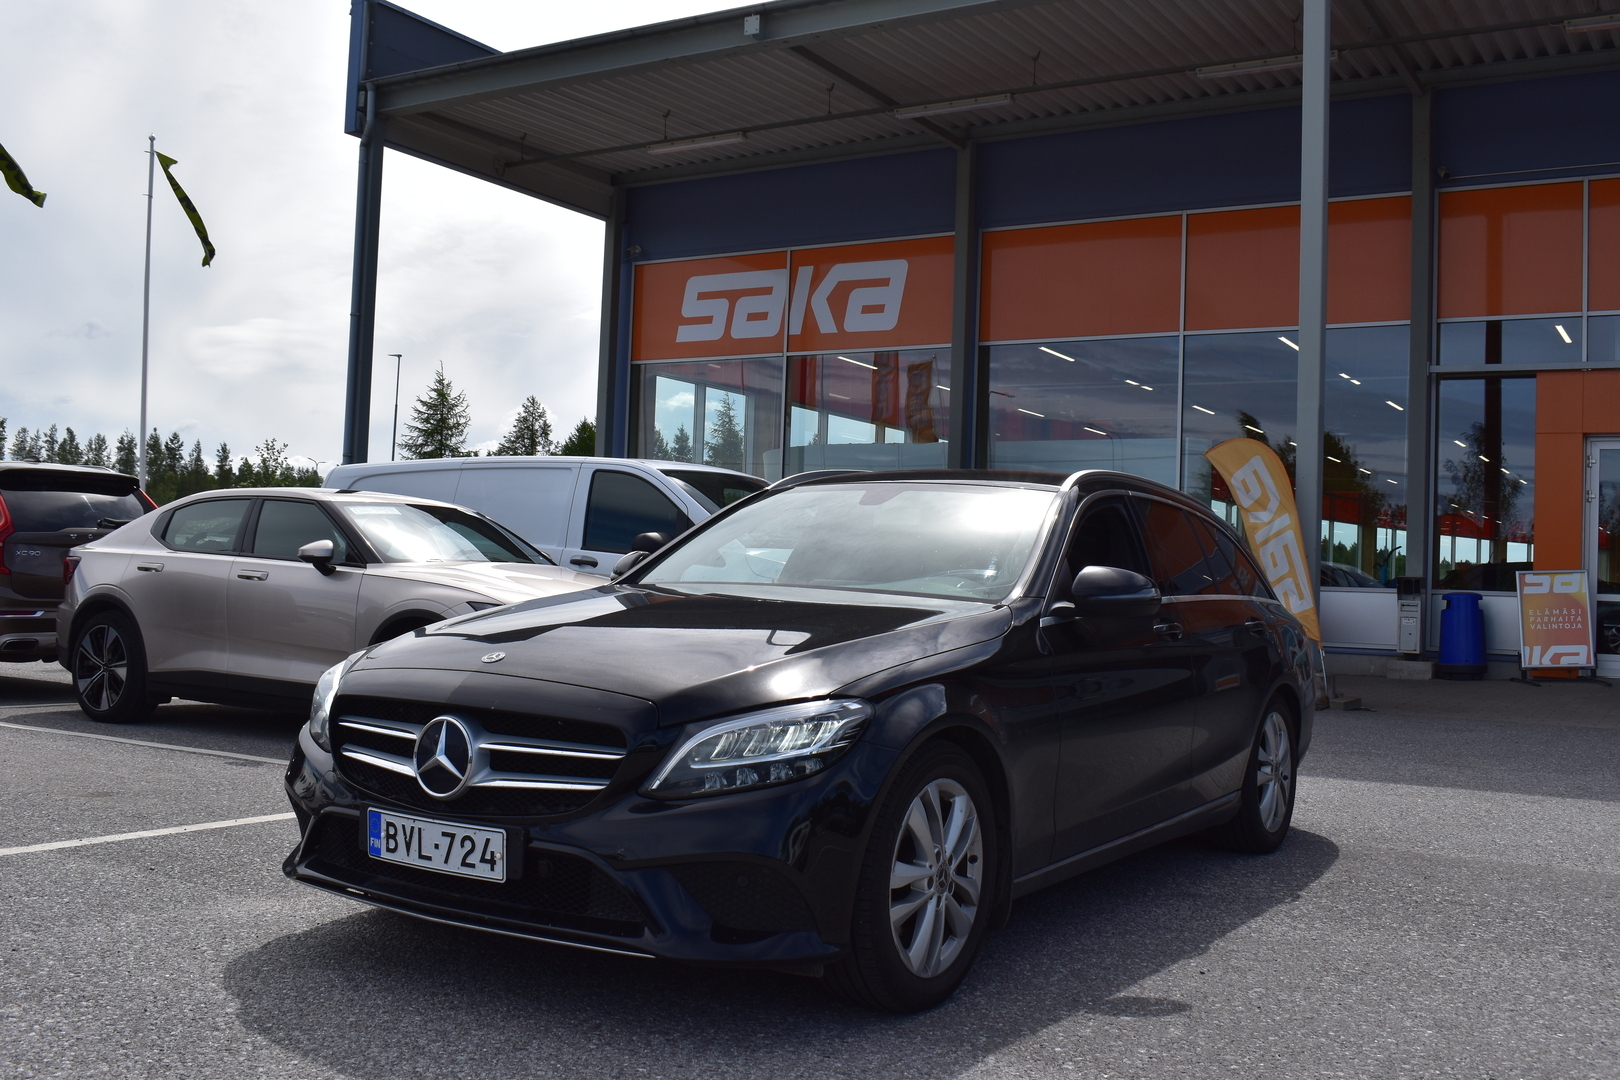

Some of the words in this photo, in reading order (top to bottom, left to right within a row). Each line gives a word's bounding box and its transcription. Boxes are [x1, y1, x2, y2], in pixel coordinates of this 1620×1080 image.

[1529, 608, 1582, 616] ELÄMÄSI
[370, 837, 381, 849] FIN
[385, 820, 497, 872] BVL-724
